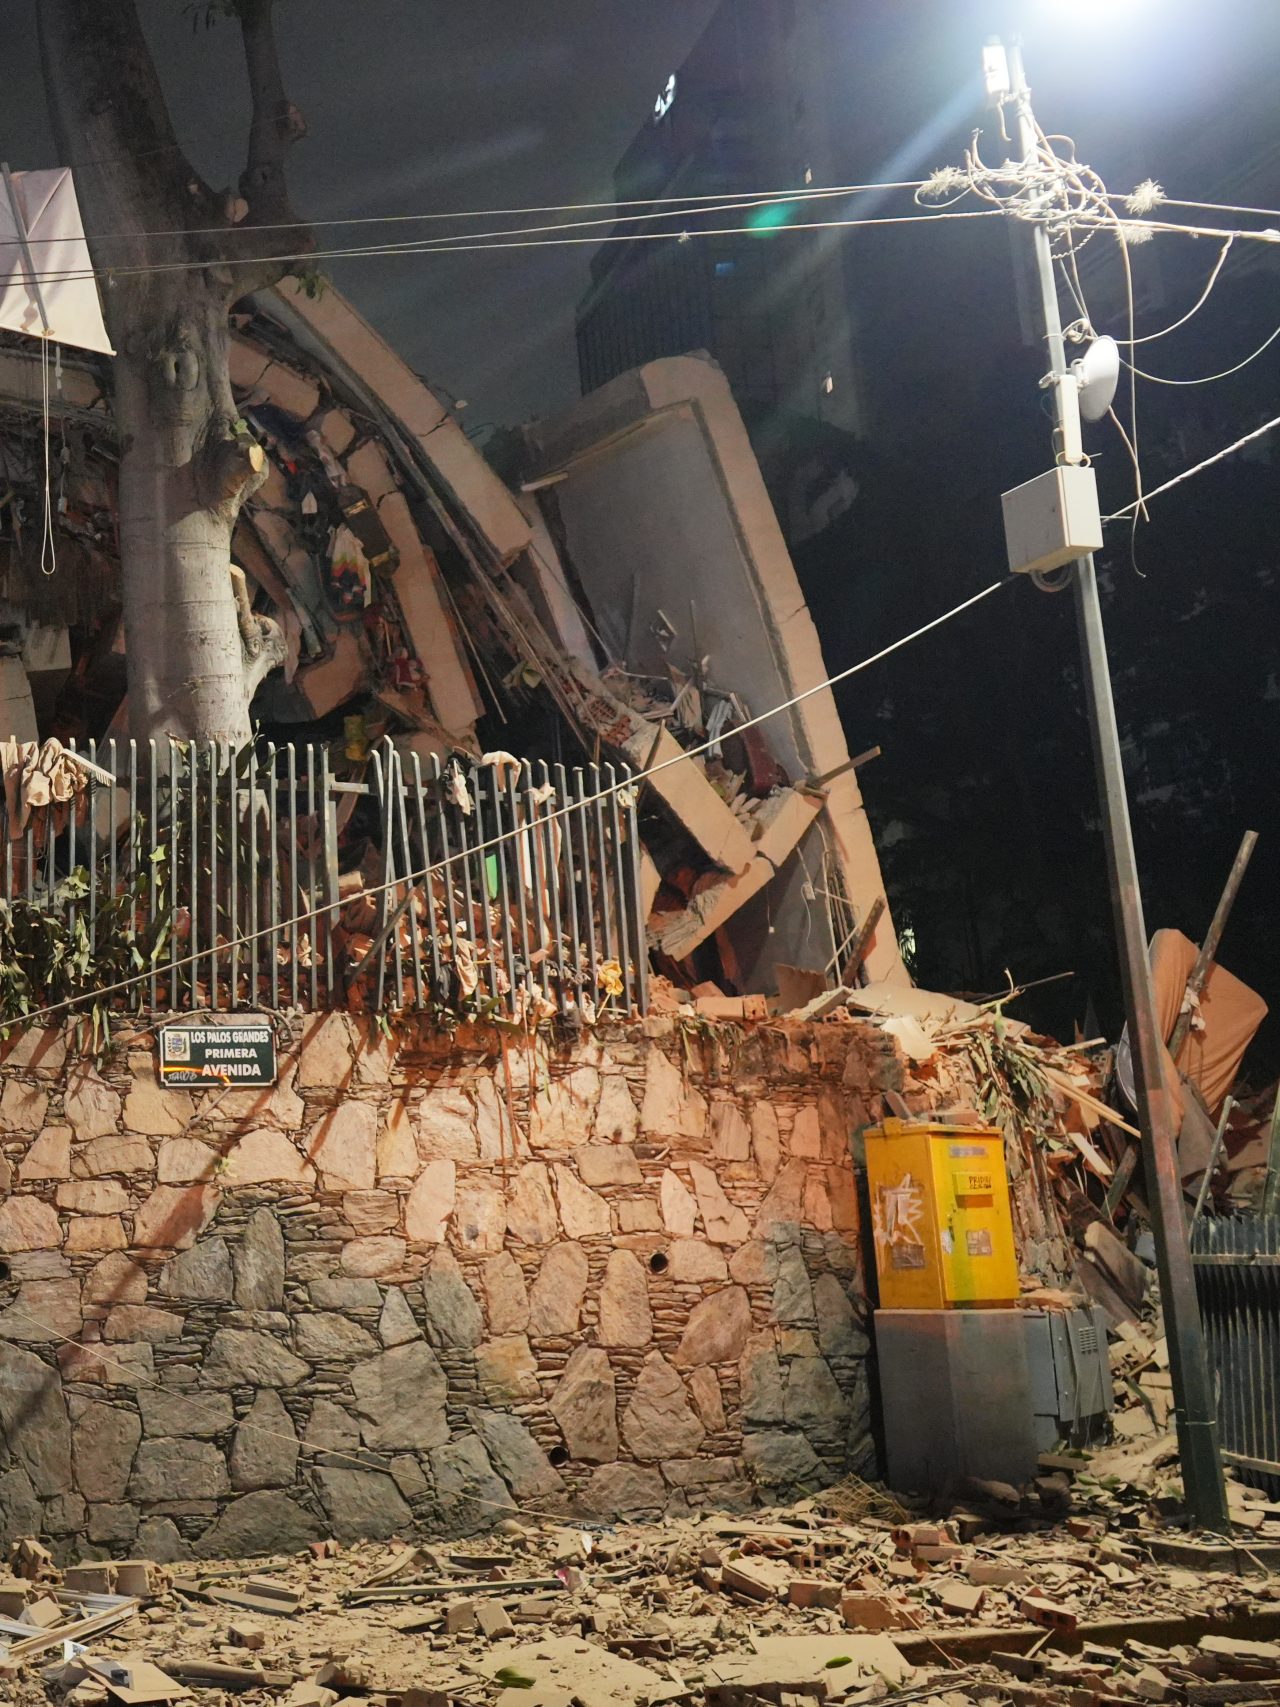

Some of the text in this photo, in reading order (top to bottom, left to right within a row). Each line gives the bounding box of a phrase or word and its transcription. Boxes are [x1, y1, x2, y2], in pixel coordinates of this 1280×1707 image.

[191, 1031, 269, 1043] LOS PALOS GRANDES
[204, 1048, 258, 1059] PRIMERA
[201, 1063, 262, 1076] AVENIDA
